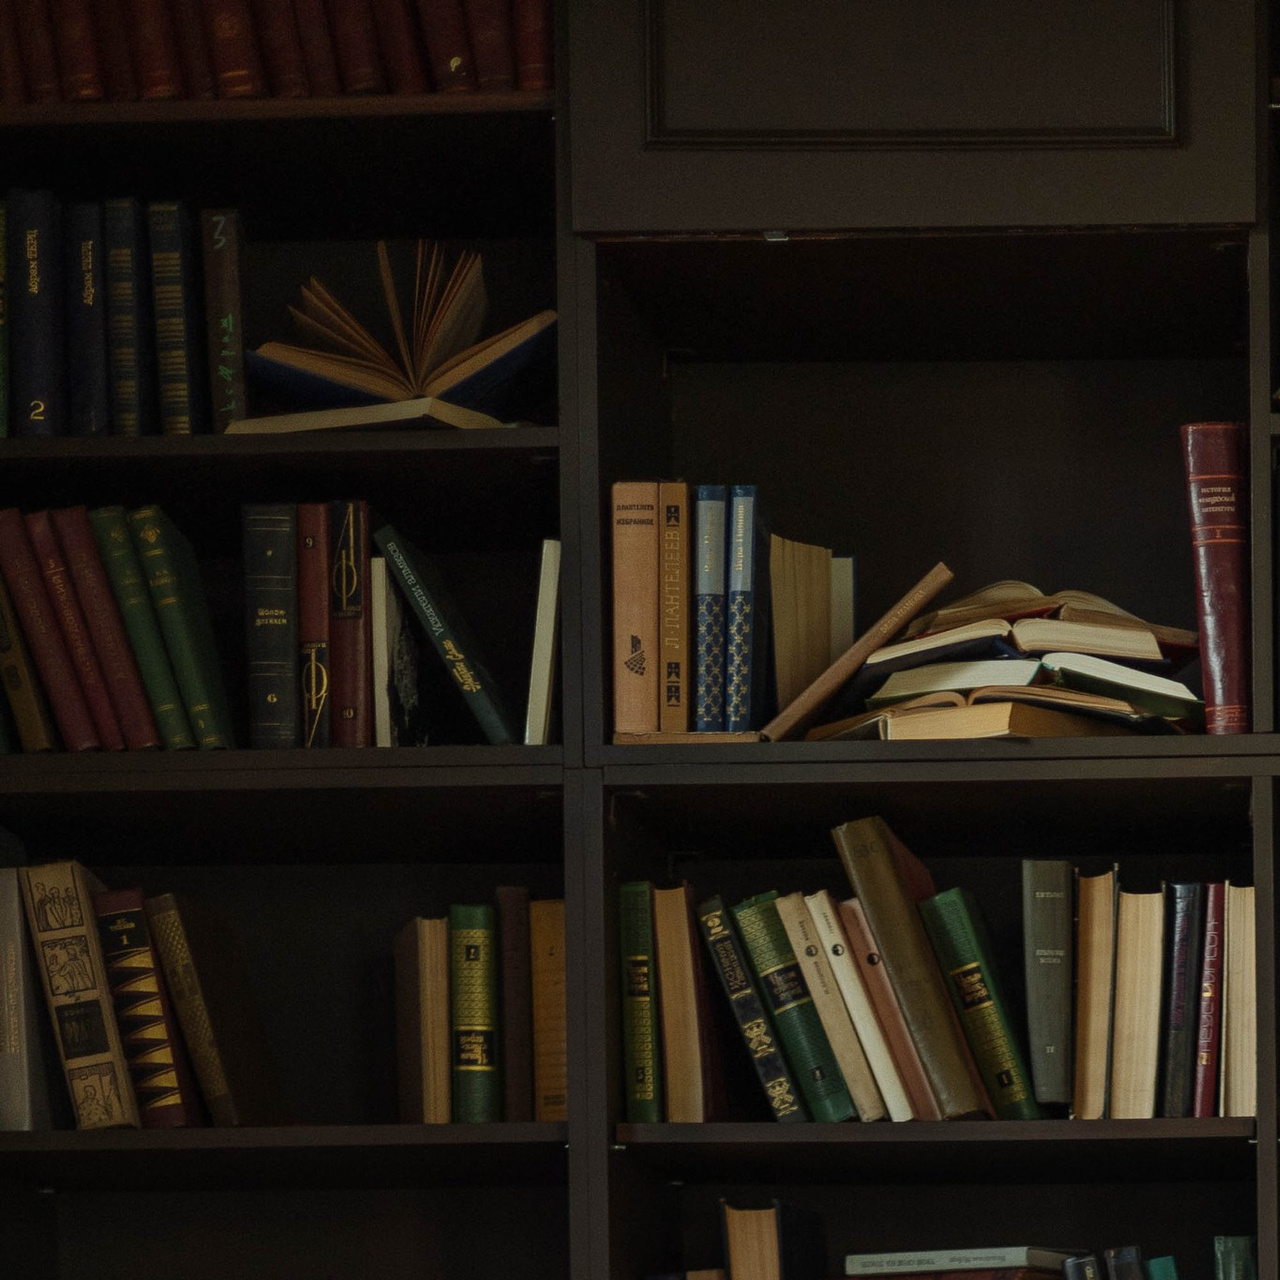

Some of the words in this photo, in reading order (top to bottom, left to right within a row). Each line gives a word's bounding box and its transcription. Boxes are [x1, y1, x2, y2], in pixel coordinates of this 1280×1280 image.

[30, 400, 45, 420] 2
[384, 539, 418, 586] алмазов
[664, 530, 679, 628] ПАНТЕЛЕЕВ
[733, 546, 744, 571] Вера
[408, 583, 447, 636] Искатели
